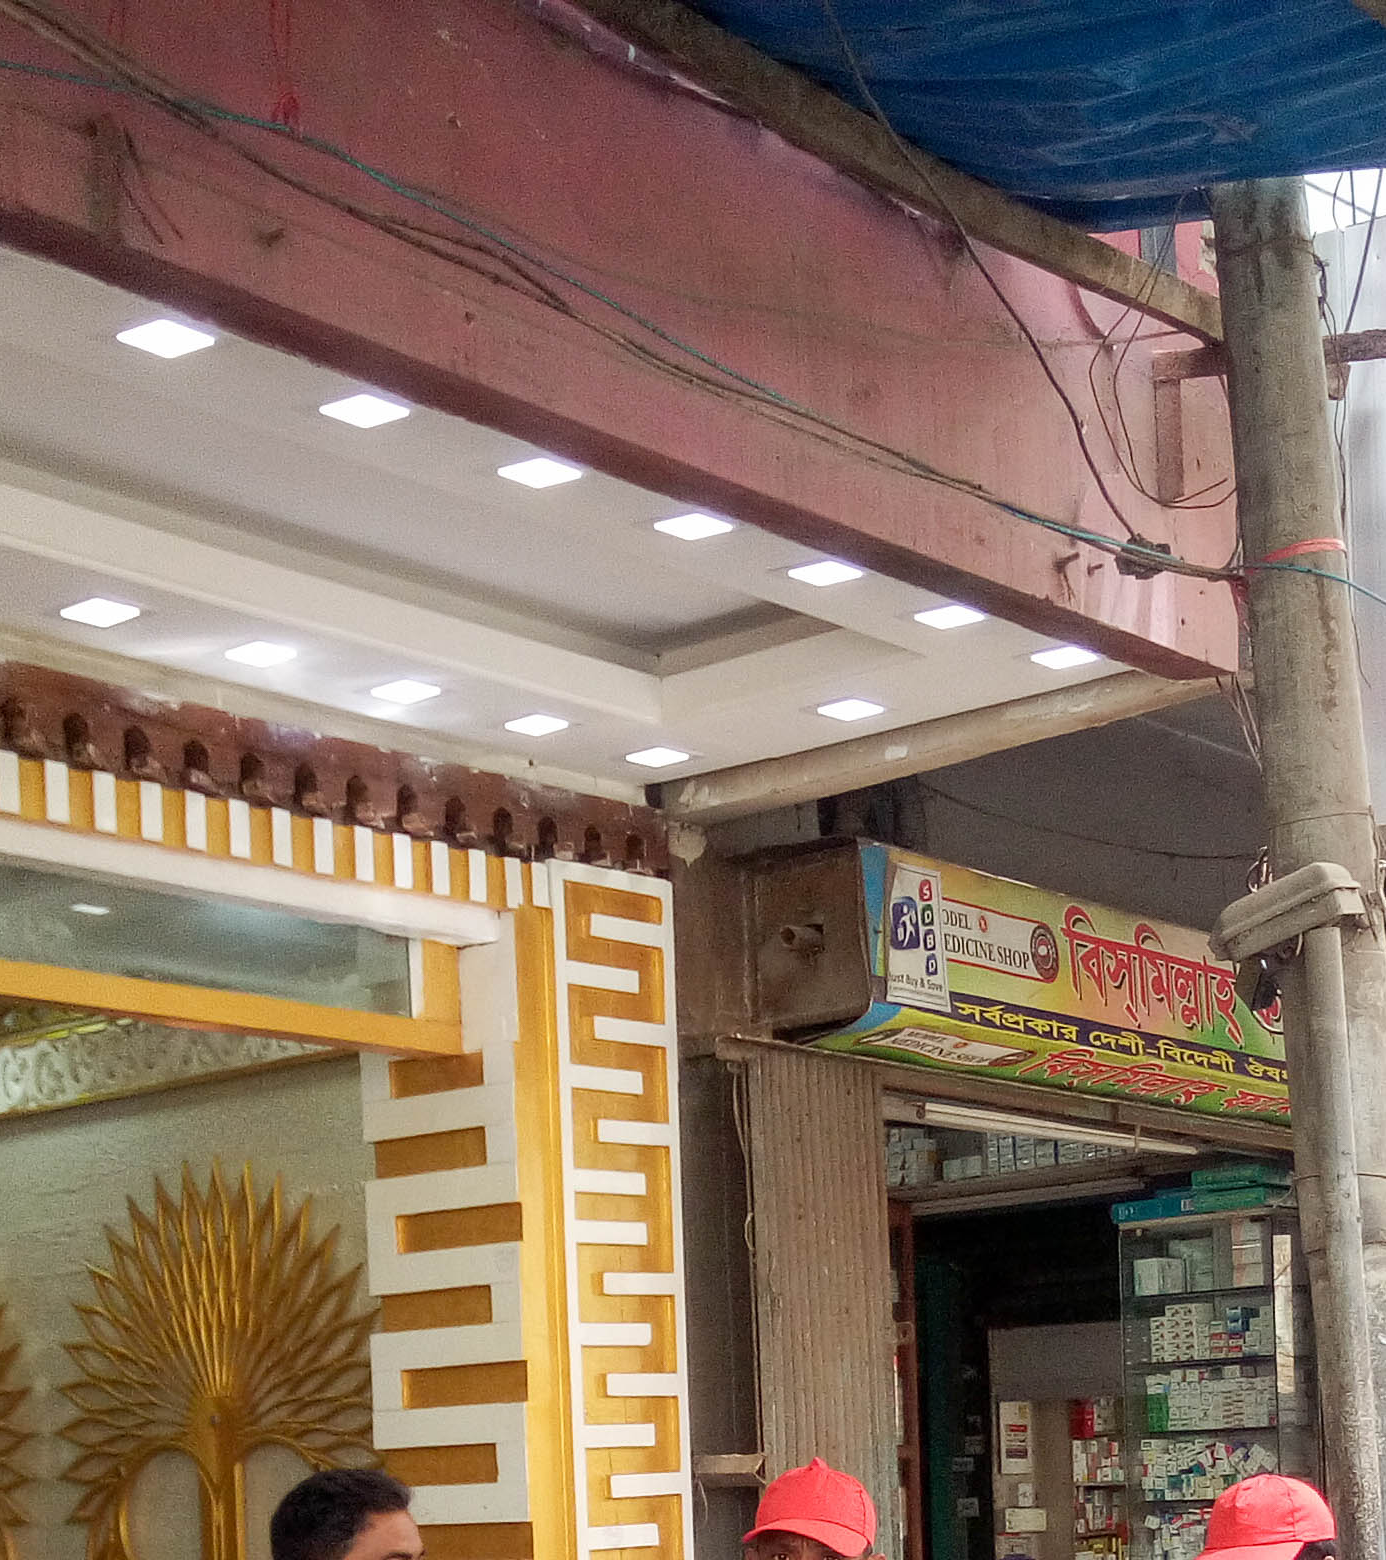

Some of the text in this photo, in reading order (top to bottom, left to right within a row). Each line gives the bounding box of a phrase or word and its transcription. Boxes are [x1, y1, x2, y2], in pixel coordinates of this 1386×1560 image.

[942, 908, 972, 930] ODEL
[944, 933, 1029, 970] EDICINE SHOP
[954, 1001, 1080, 1042] সর্বপ্রকার
